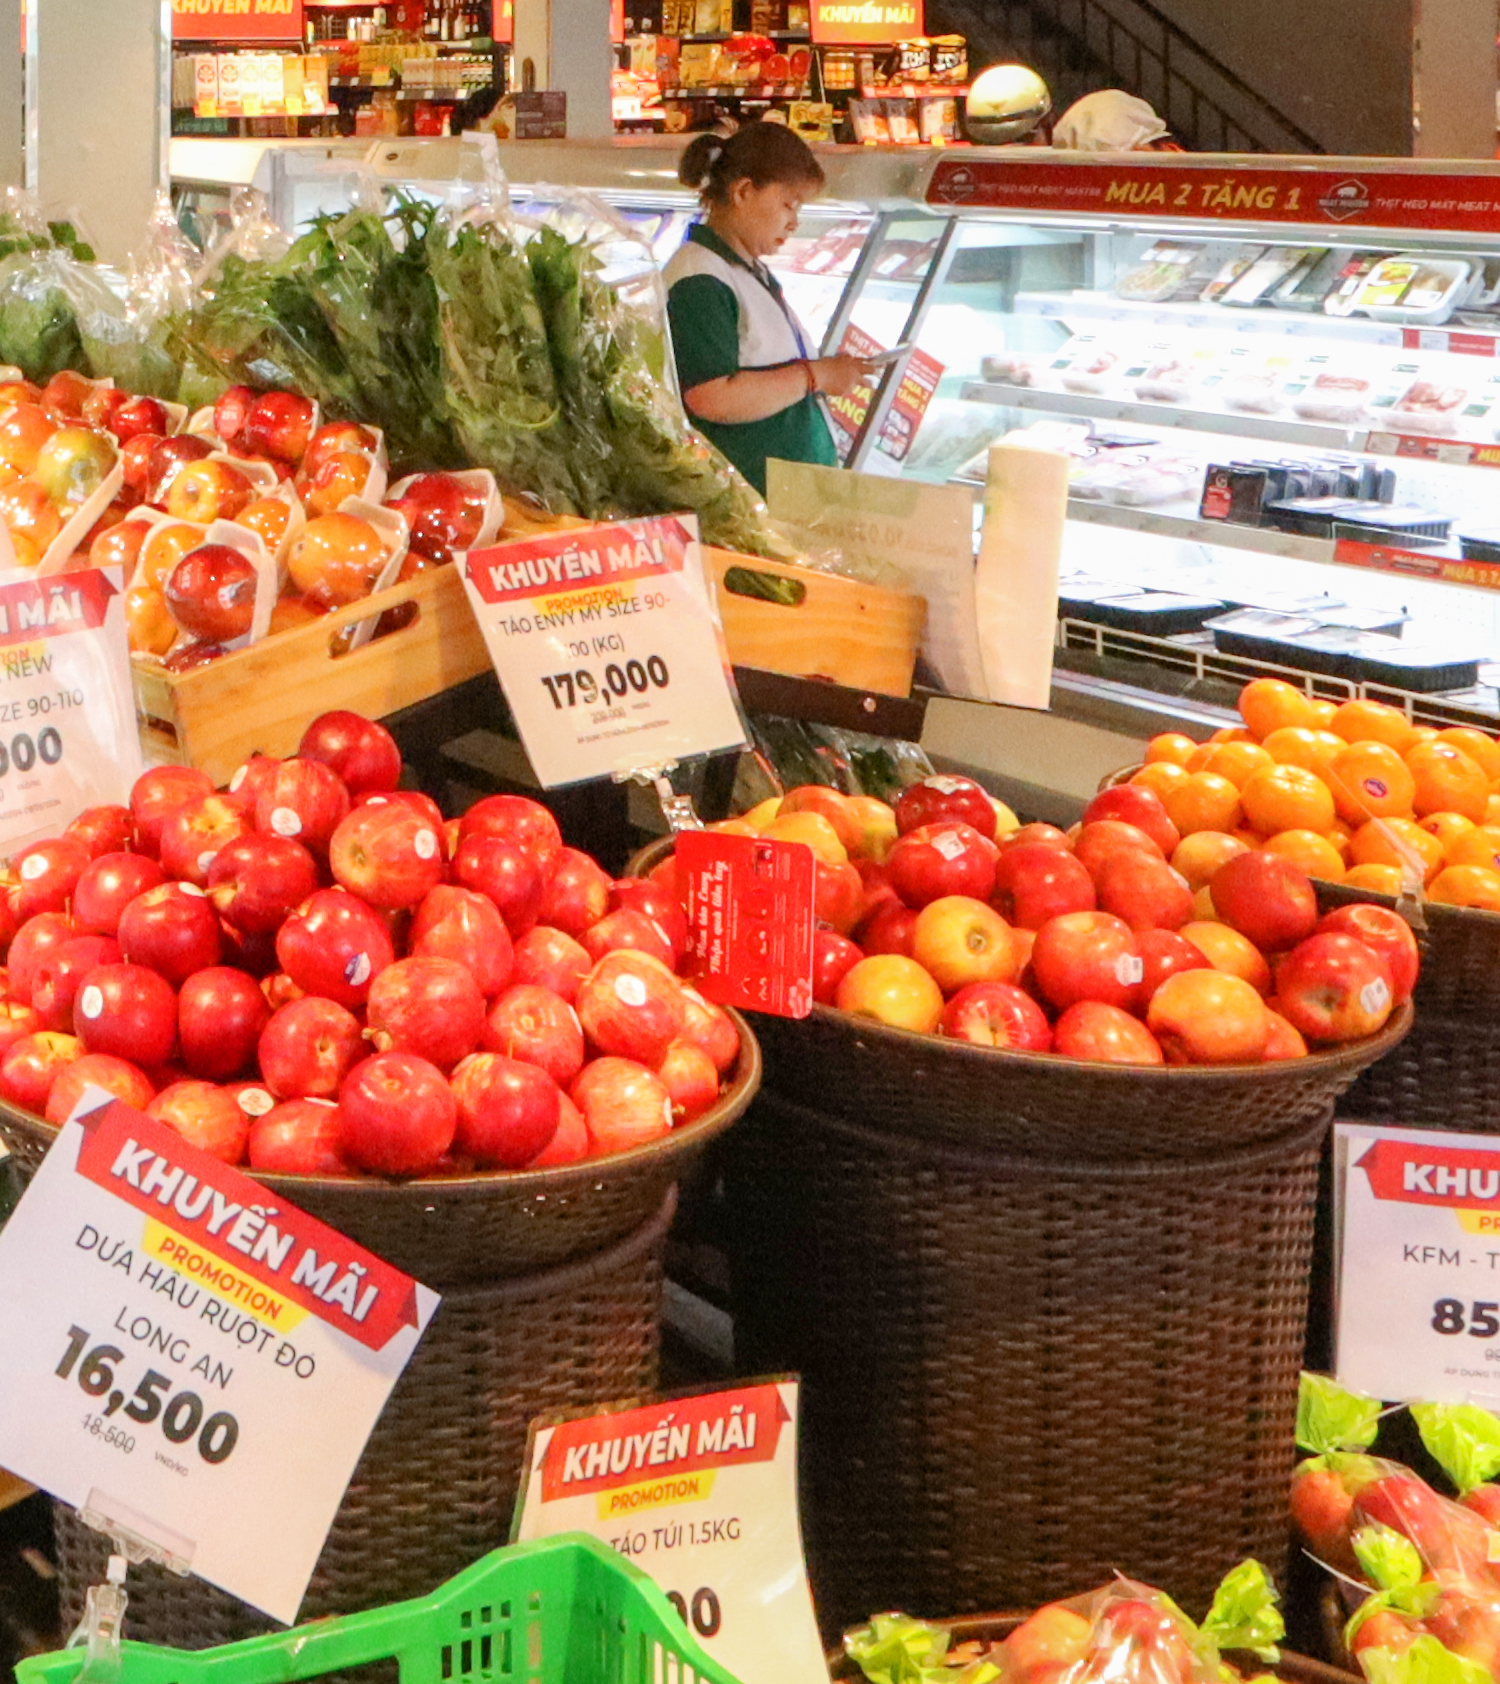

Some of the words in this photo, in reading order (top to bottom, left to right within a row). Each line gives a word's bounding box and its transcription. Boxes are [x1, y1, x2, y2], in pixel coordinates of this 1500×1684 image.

[1106, 181, 1165, 205] MUA
[1174, 183, 1192, 206] 2
[1201, 178, 1276, 214] TẶNG
[1285, 189, 1300, 210] 1
[489, 542, 603, 592] KHUYẾN
[607, 531, 666, 572] MÃI
[1442, 565, 1476, 582] MUA
[19, 586, 84, 628] MÃI
[500, 615, 532, 637] TÁO
[537, 609, 575, 631] ENVY
[608, 596, 641, 618] SIZE
[646, 594, 671, 610] 90-
[545, 588, 623, 610] PROMOTION
[593, 633, 625, 656] (KG)
[7, 654, 54, 681] NEW
[541, 655, 670, 710] 179,000
[27, 688, 85, 716] 90-110
[110, 1138, 295, 1274] KHUYẾN
[291, 1247, 378, 1322] MÃI
[1403, 1244, 1459, 1267] KFM
[159, 1238, 283, 1320] PROMOTION
[74, 1223, 133, 1276] DƯA
[275, 1337, 316, 1381] ĐỎ
[113, 1306, 189, 1363] LONG
[192, 1355, 234, 1390] AN
[53, 1324, 240, 1465] 16,500
[82, 1413, 136, 1455] 18,500
[562, 1414, 690, 1482] KHUYẾN
[696, 1405, 757, 1455] MÃI
[610, 1478, 699, 1513] PROMOTION
[610, 1530, 646, 1556] TÁO
[653, 1520, 682, 1549] TÚI
[689, 1518, 741, 1546] 1.5KG
